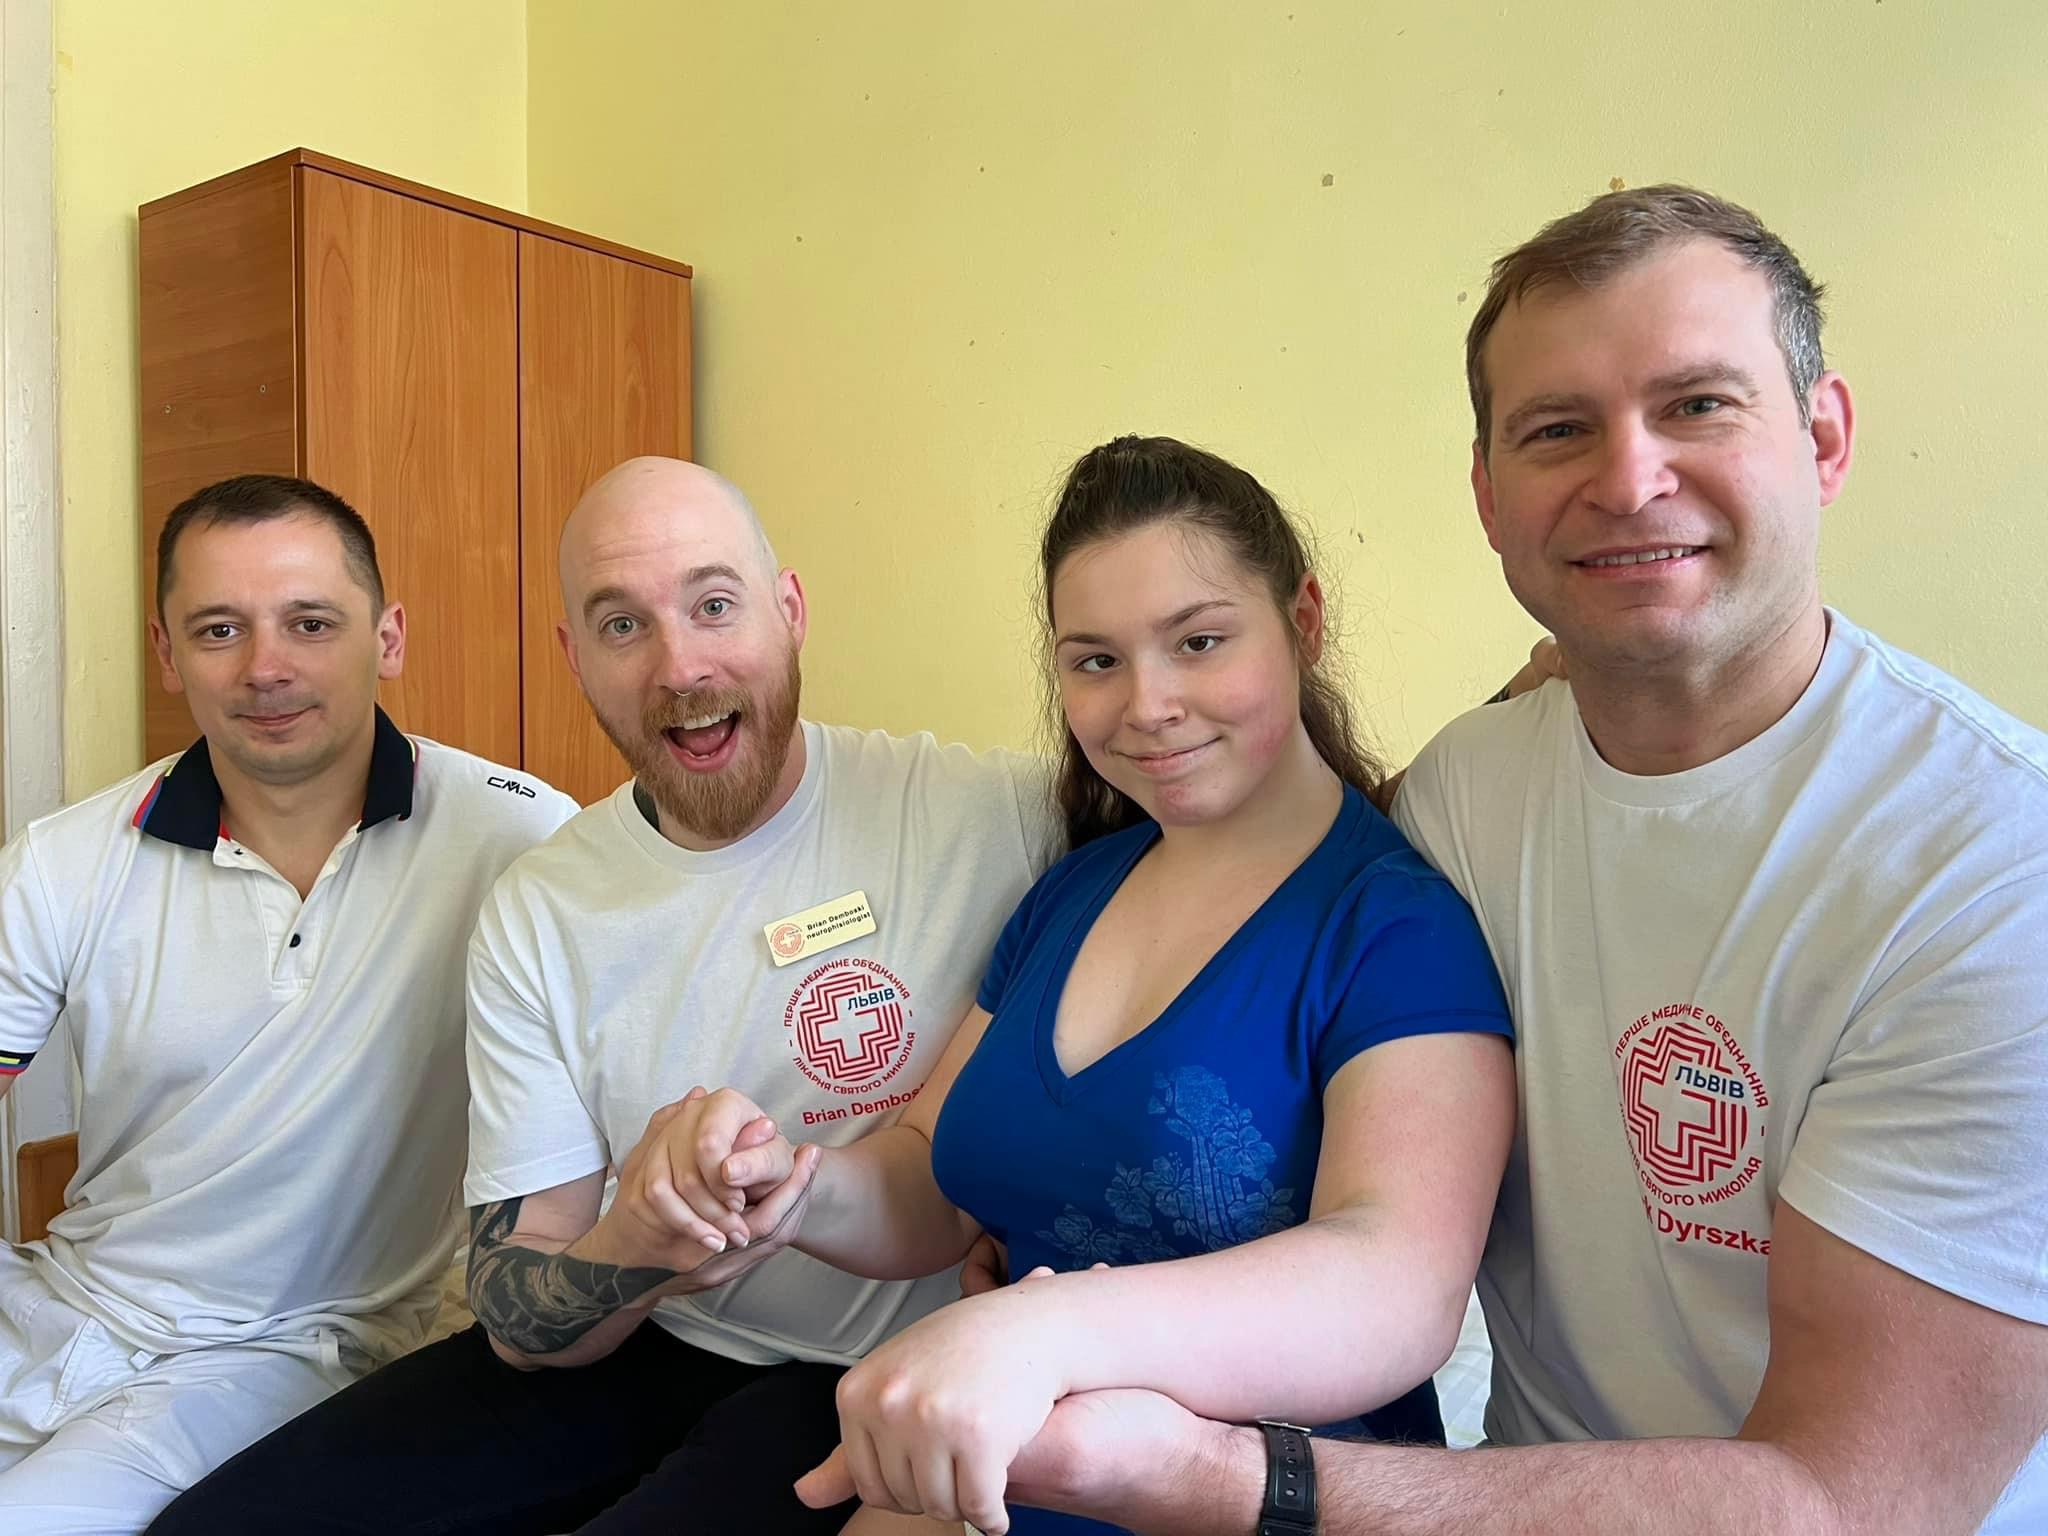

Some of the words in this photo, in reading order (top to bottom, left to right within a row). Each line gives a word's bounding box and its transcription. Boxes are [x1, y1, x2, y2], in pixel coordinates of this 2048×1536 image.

[487, 776, 536, 798] CMP
[807, 919, 828, 930] Brian
[784, 990, 803, 1027] ПЕРШЕ
[800, 958, 850, 989] МЕДИЧНЕ
[847, 988, 895, 1010] ЛЬВІВ
[1615, 1014, 1650, 1058] ПЕРШЕ
[793, 1057, 831, 1092] ЛІКАРНЯ
[833, 1080, 881, 1095] СВЯТОГО
[882, 1032, 916, 1083] МИКОЛАЯ
[1675, 1065, 1745, 1099] ЛЬВІВ
[802, 1108, 847, 1125] Brian
[851, 1083, 924, 1116] Dembos
[1641, 1170, 1695, 1206] СВЯТОГО
[1698, 1156, 1762, 1205] МИКОЛАЯ
